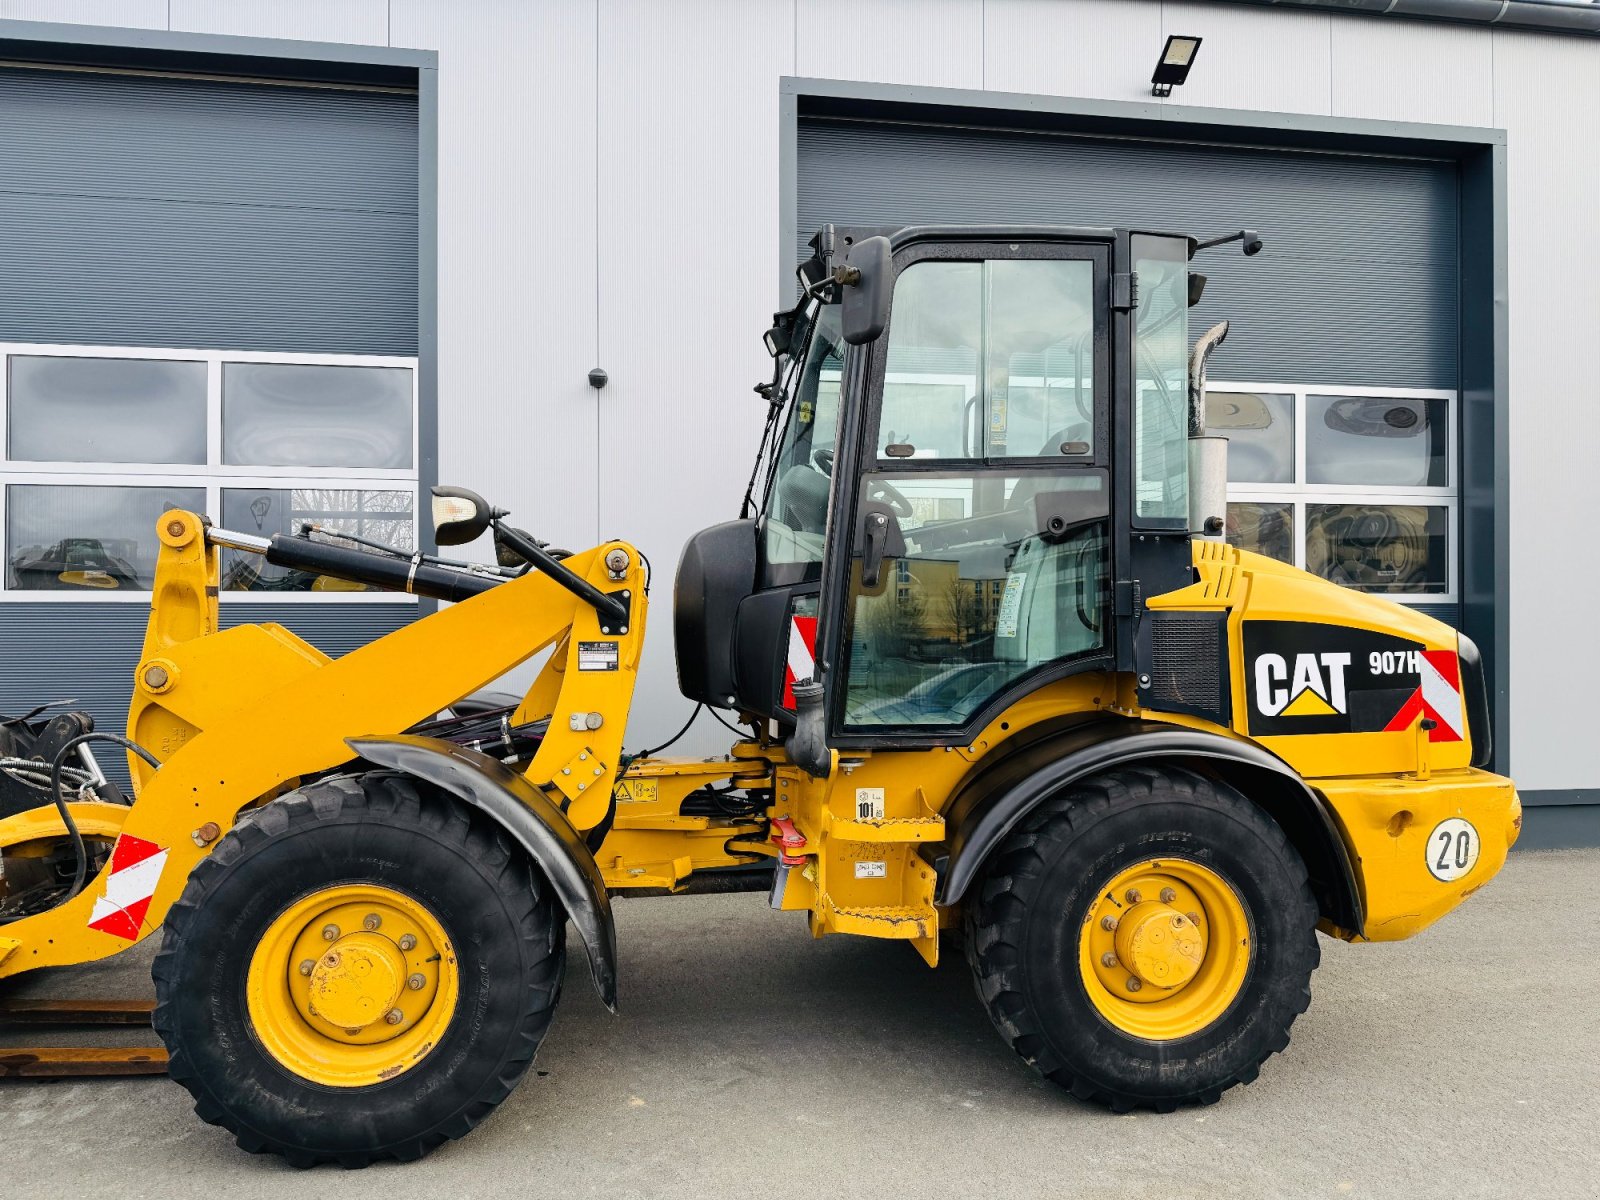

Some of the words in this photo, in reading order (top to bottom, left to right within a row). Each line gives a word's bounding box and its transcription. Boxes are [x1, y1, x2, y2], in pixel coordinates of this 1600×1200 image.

[1369, 651, 1421, 675] 907H
[1255, 652, 1351, 717] CAT
[858, 802, 873, 818] 101
[1437, 831, 1470, 870] 20
